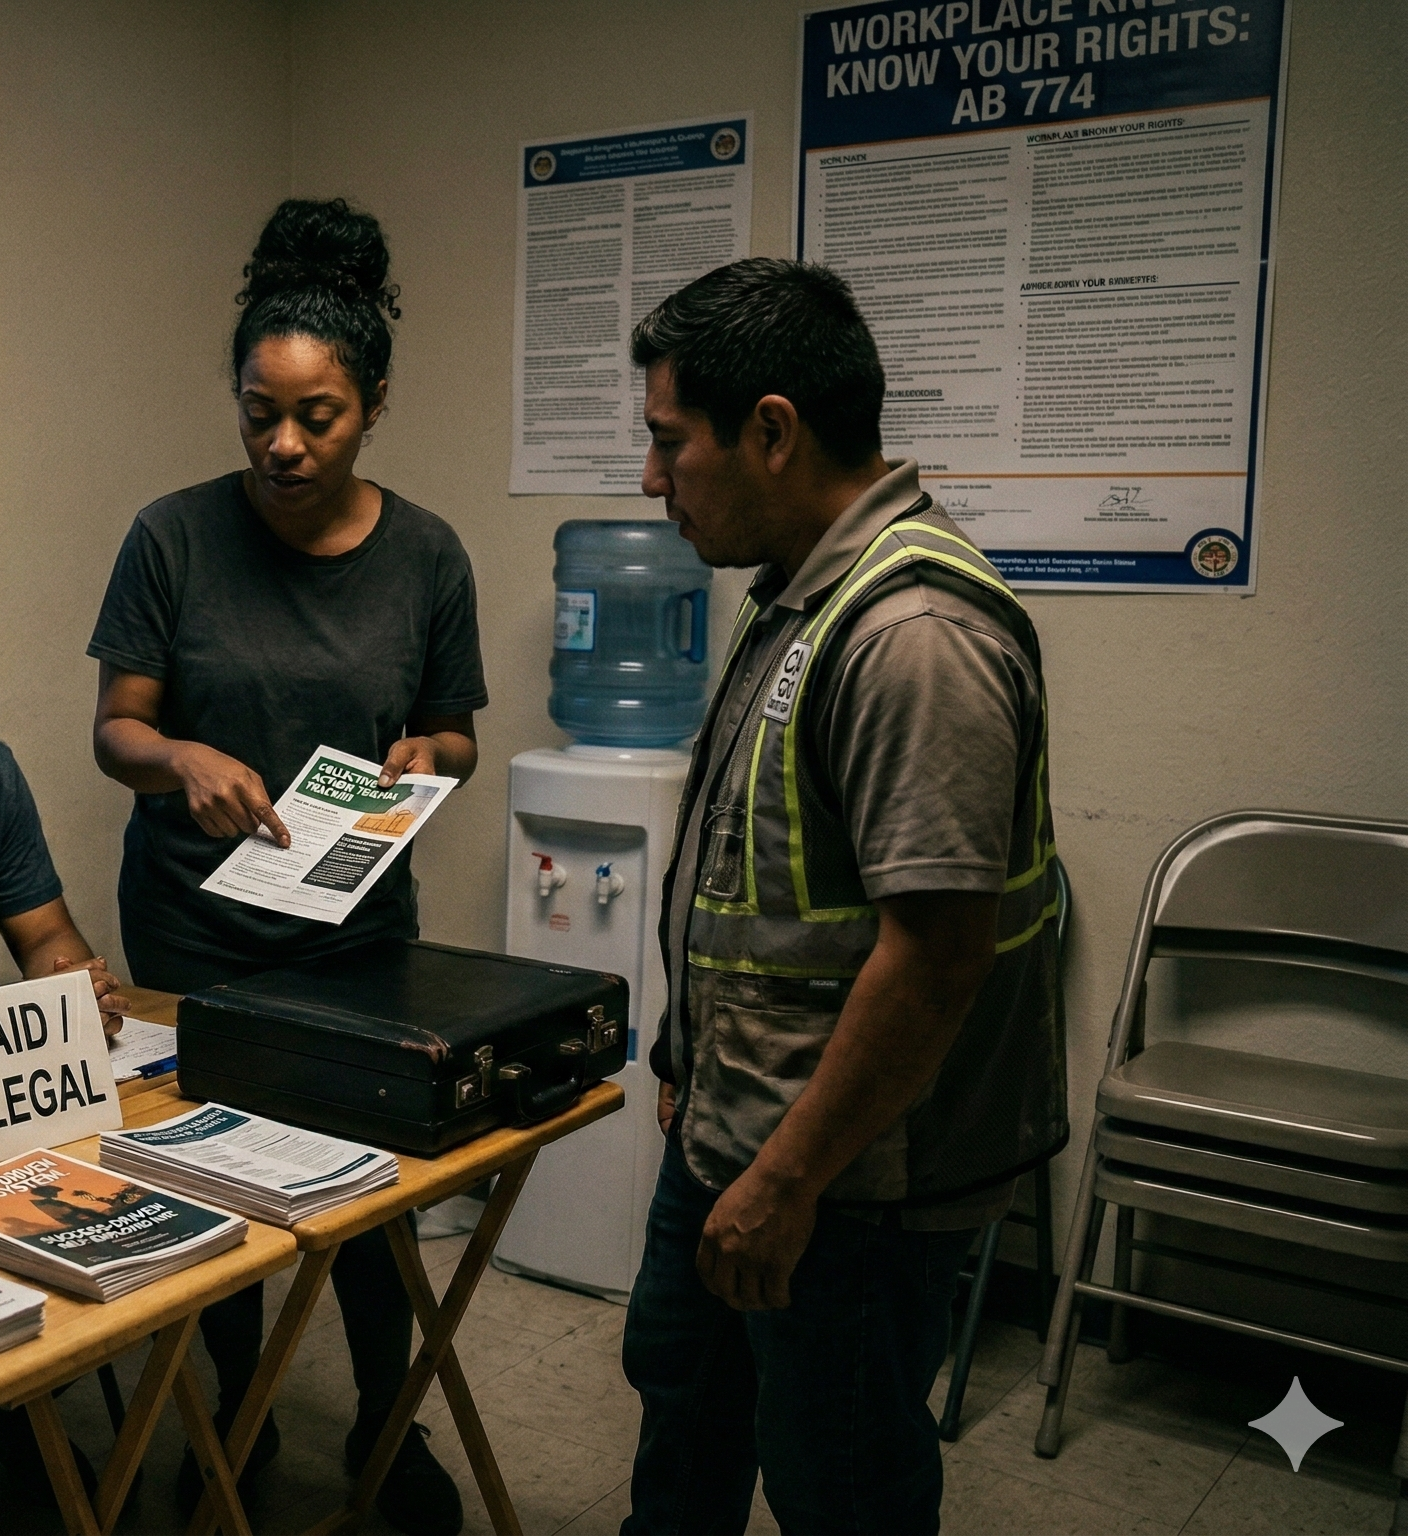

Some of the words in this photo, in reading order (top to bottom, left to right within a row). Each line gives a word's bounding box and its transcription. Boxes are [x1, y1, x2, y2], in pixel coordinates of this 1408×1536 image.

[826, 49, 940, 98] KNOW
[953, 31, 1060, 80] YOUR
[1075, 6, 1251, 65] RIGHTS:
[830, 0, 1073, 54] WORKPLACE
[951, 85, 1006, 125] AB
[1021, 72, 1096, 116] 774
